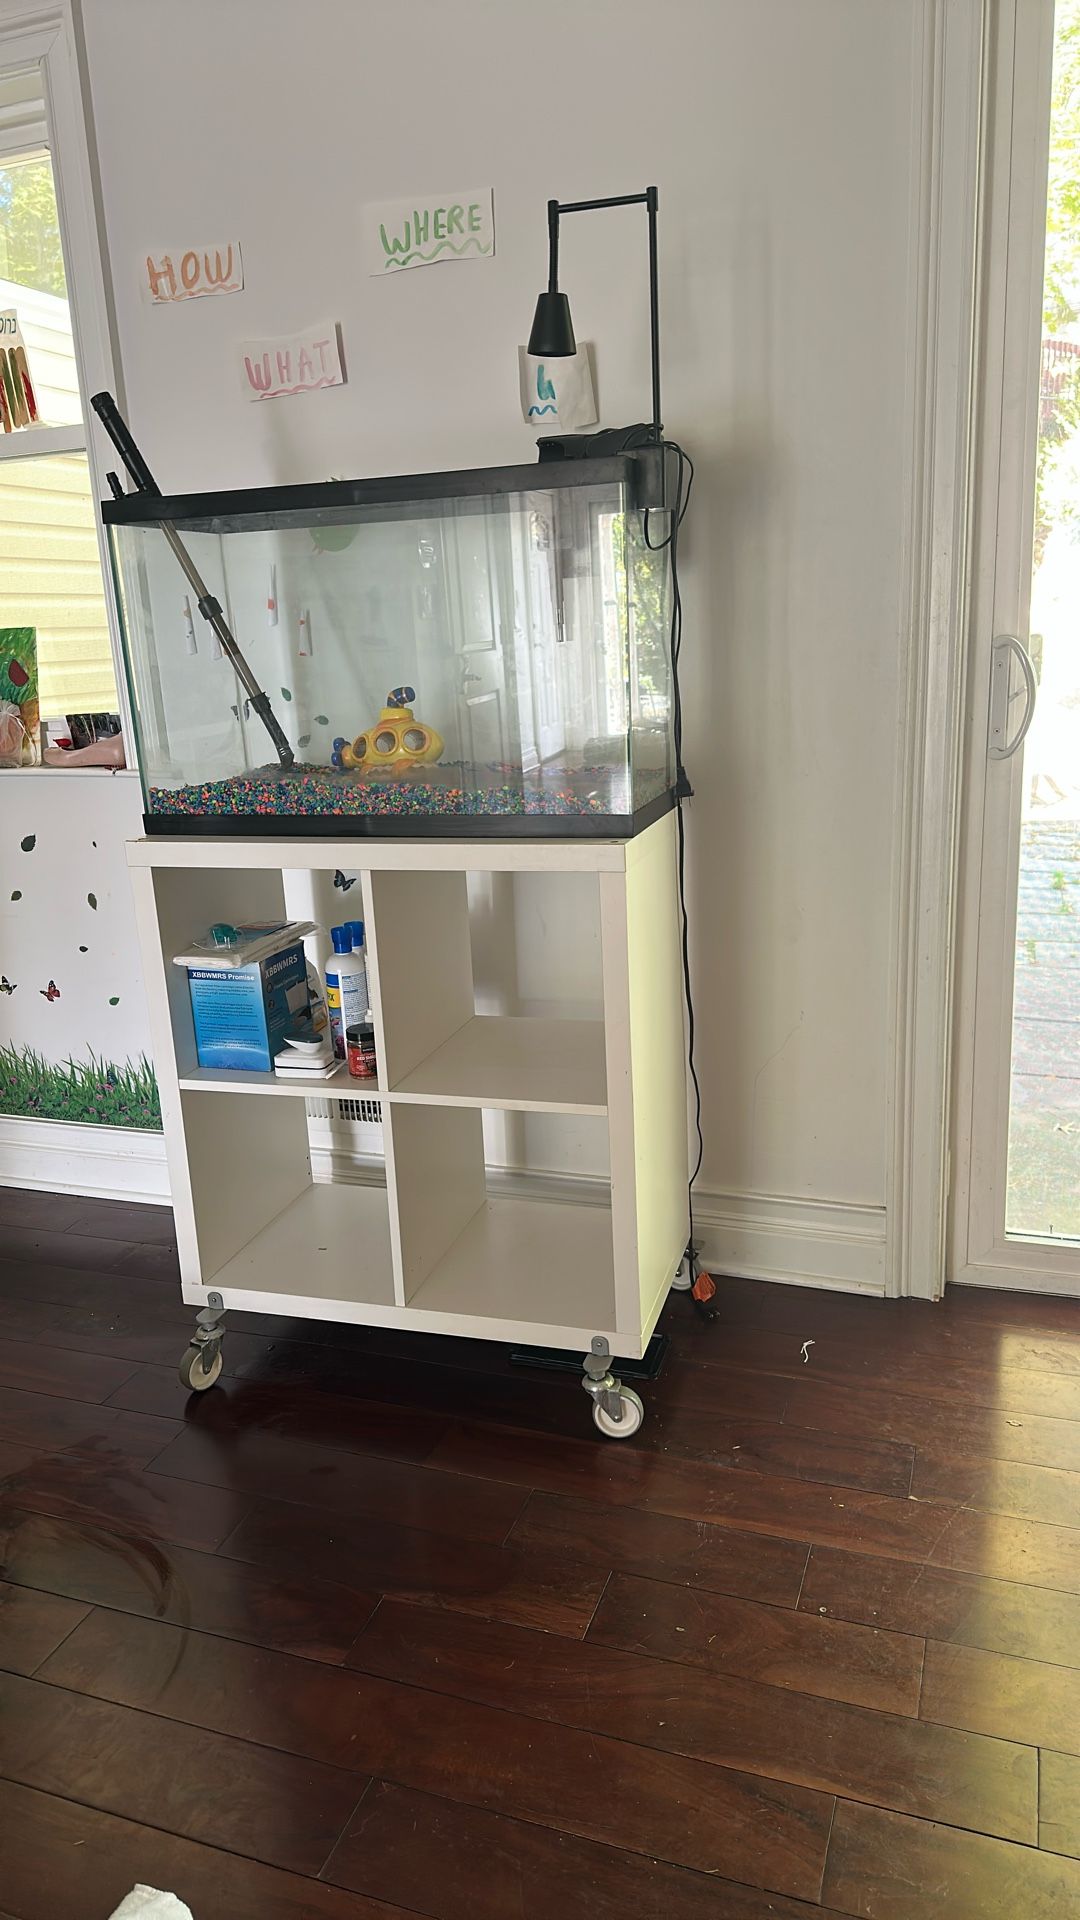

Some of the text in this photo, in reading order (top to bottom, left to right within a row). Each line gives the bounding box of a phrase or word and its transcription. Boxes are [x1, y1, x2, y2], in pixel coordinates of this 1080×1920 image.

[379, 203, 483, 256] WHERE
[146, 242, 233, 297] HOW
[244, 340, 331, 392] WHAT
[192, 971, 255, 981] XBBWMRS Promise
[265, 954, 298, 979] XBBWMRS
